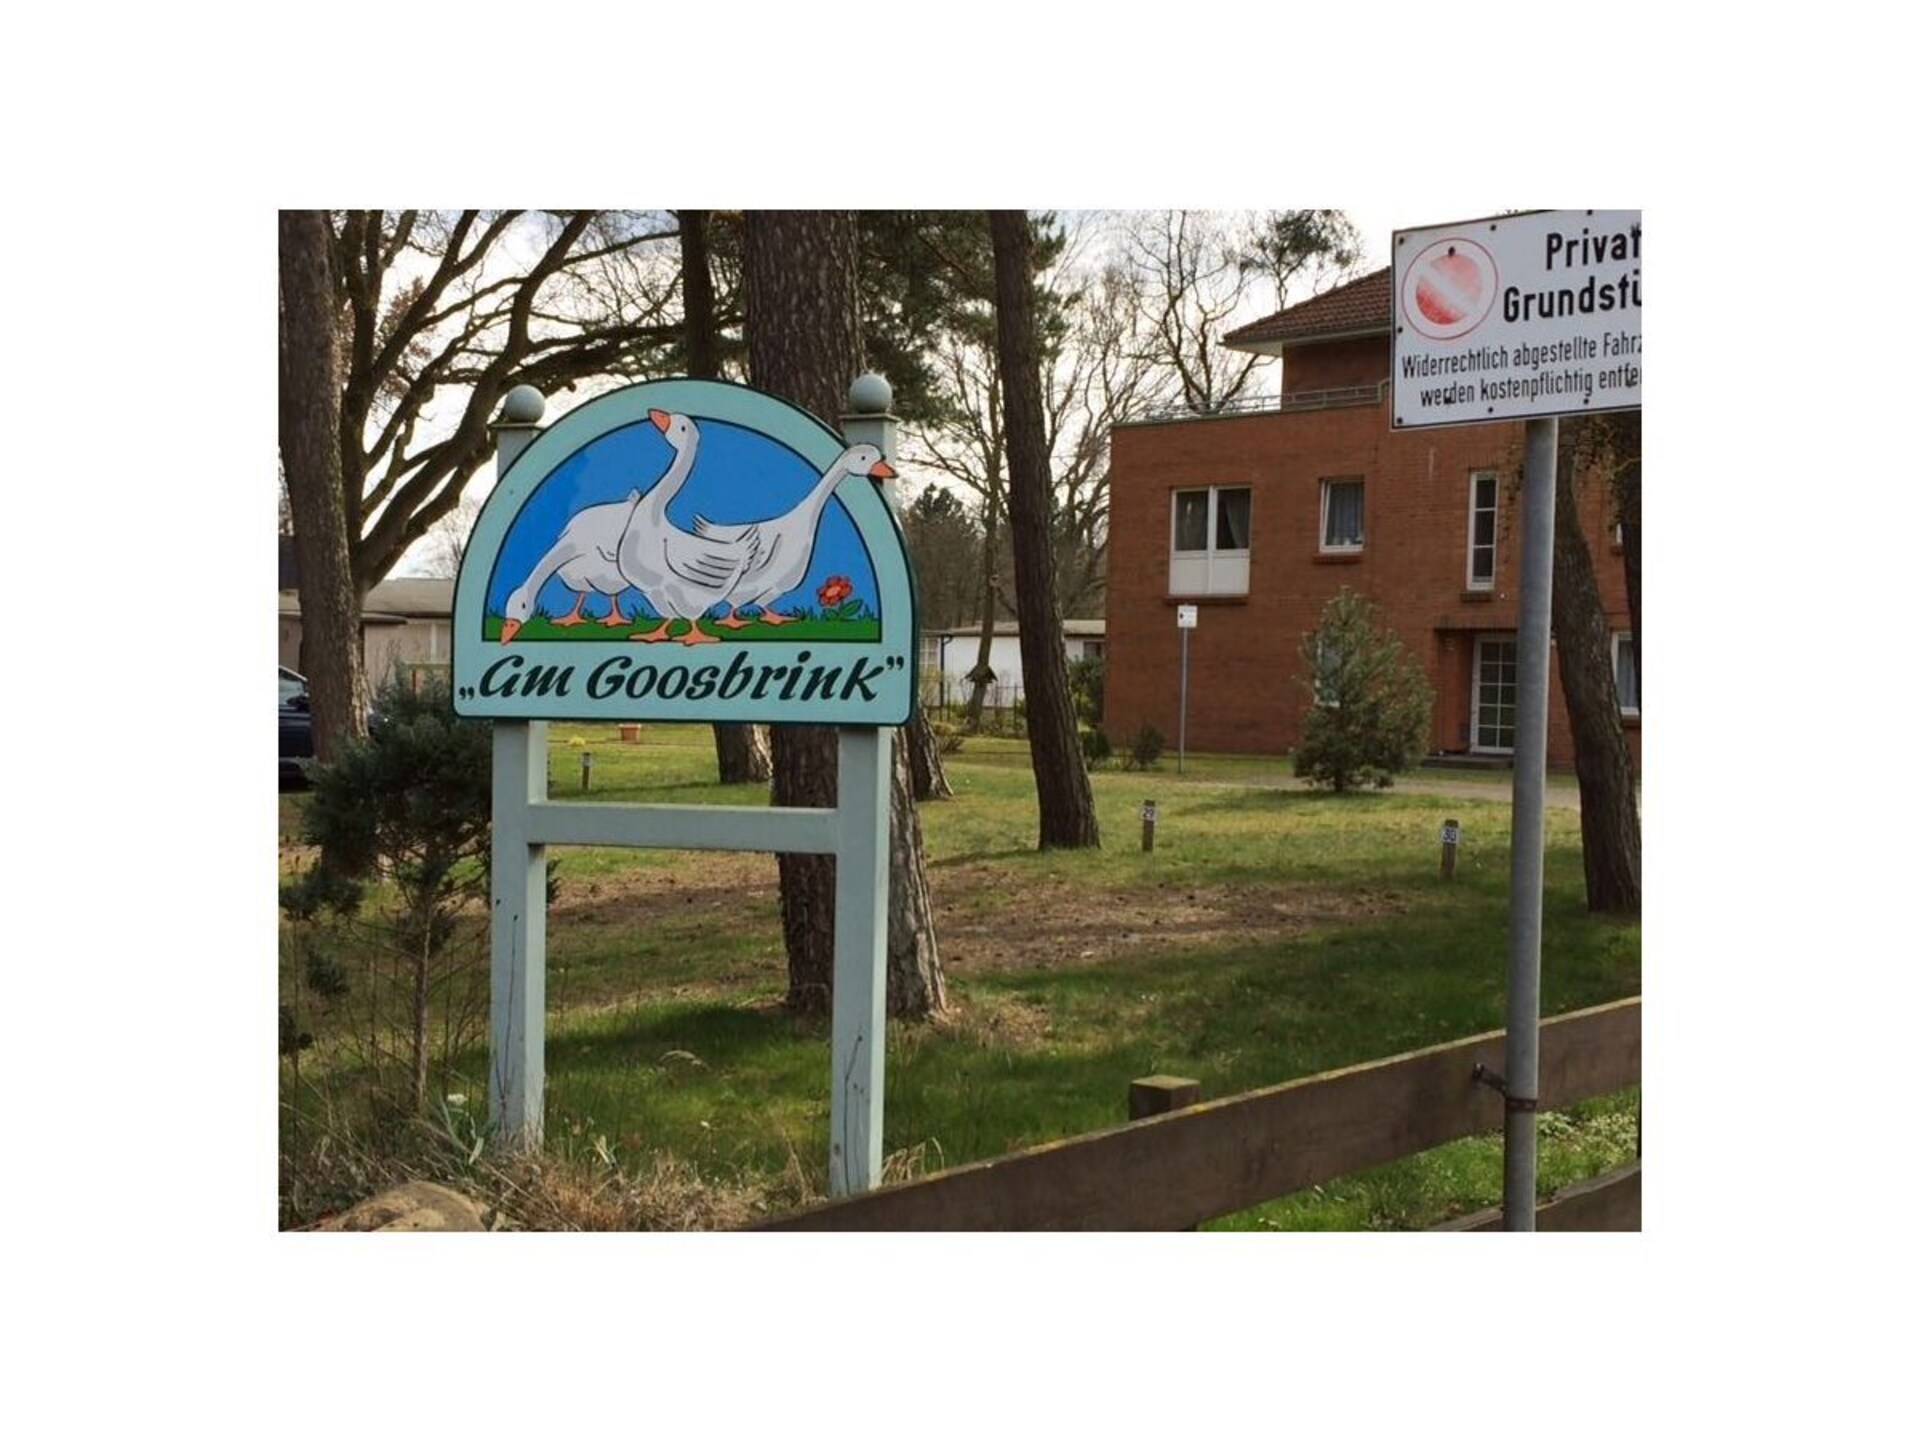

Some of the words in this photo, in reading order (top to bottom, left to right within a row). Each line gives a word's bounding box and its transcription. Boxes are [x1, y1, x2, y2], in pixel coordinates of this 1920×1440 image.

[1545, 224, 1642, 271] Privat
[1402, 348, 1508, 379] Widerrechtlich
[1513, 336, 1597, 371] abgestellte
[1420, 382, 1475, 408] werden
[1480, 369, 1594, 402] kostenpflichtig
